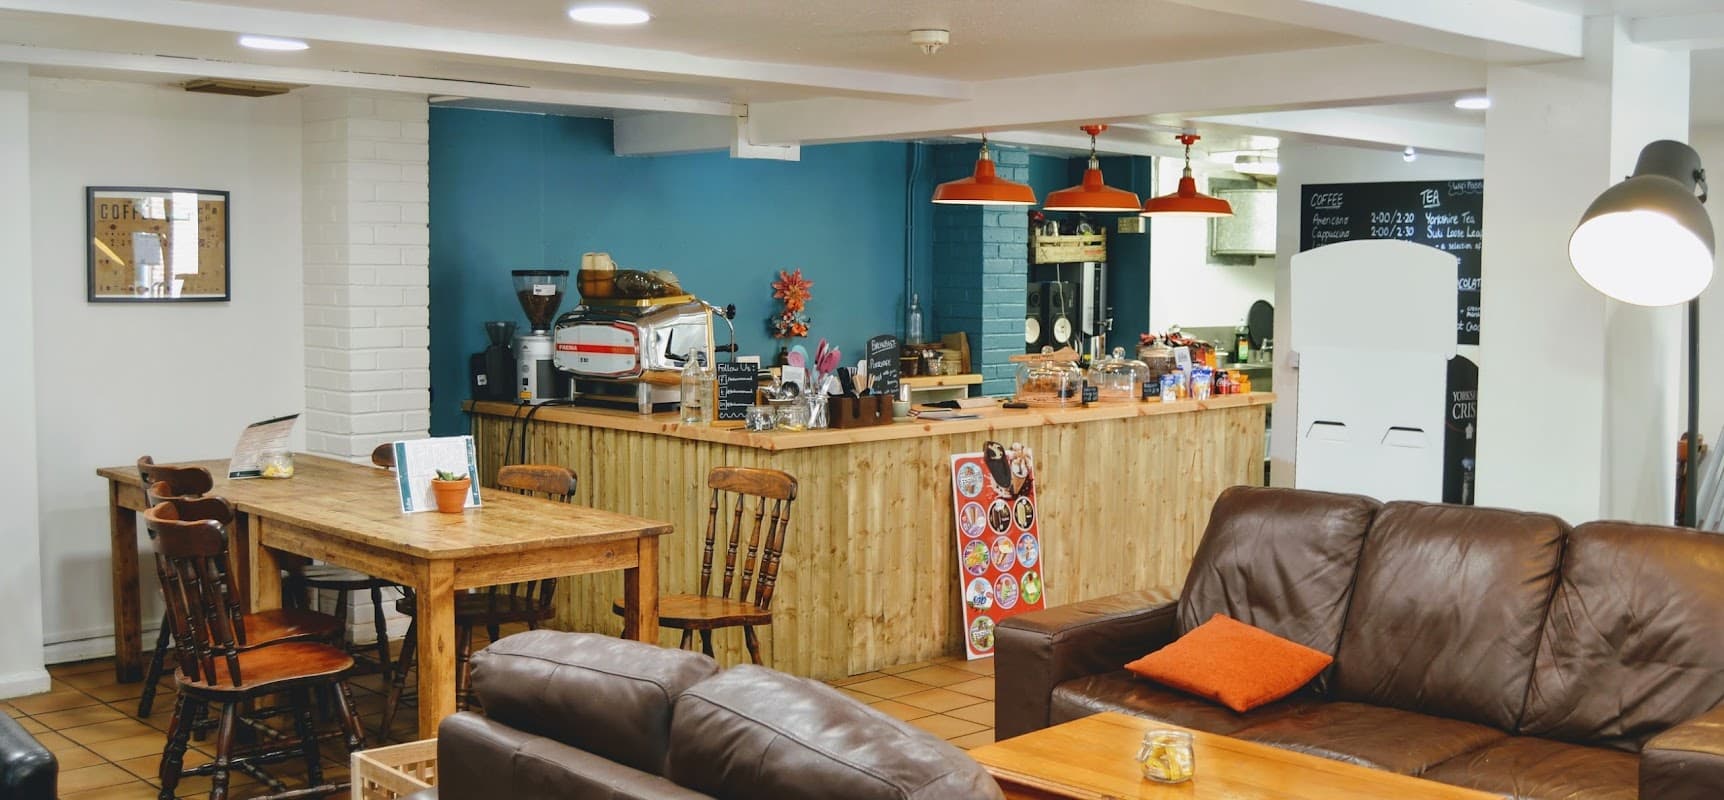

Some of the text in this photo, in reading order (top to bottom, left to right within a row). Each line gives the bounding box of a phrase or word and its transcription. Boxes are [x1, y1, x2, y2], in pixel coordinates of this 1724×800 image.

[1311, 193, 1343, 207] COFFEE
[1420, 189, 1440, 205] TEA
[1313, 213, 1349, 225] Americano
[1425, 211, 1476, 225] Yorkshire Tea
[1312, 226, 1350, 241] Cappuccino
[1446, 227, 1465, 238] Loose
[718, 364, 739, 372] Follow
